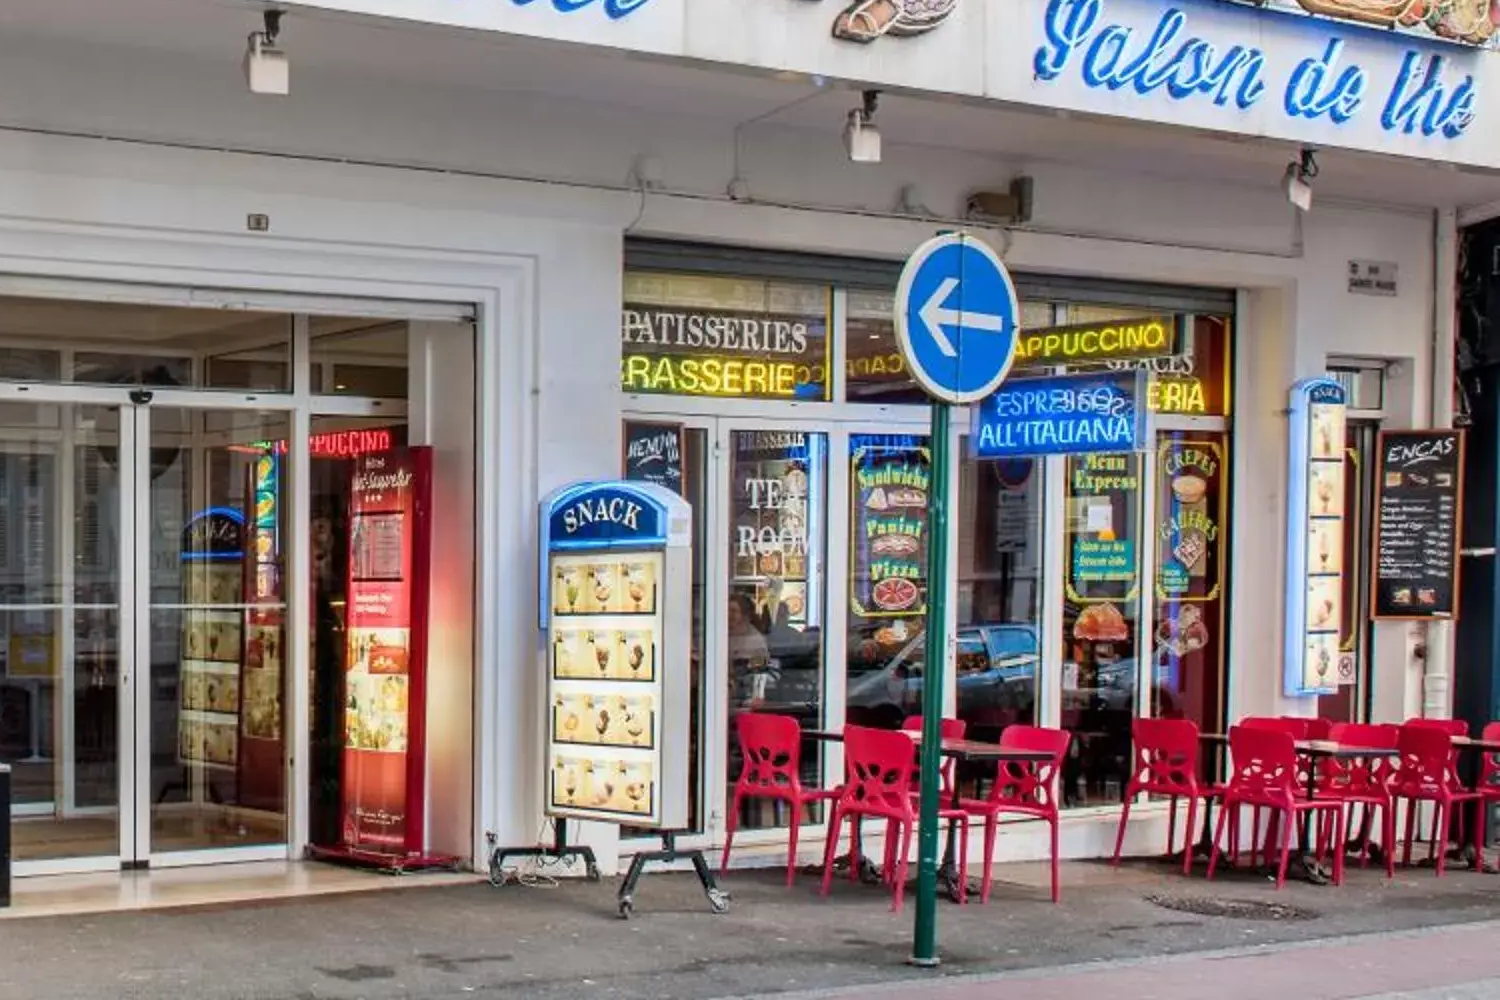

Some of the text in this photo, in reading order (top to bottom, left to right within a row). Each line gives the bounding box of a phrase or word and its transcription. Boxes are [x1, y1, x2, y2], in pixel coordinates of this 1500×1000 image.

[1284, 37, 1368, 124] de
[622, 311, 808, 354] PATISSERIES
[1013, 322, 1165, 358] APPUCCINO
[620, 354, 797, 394] RASSERIE
[1387, 437, 1456, 463] ENCAS
[1074, 469, 1138, 494] Express
[562, 496, 643, 534] SNACK
[866, 516, 923, 538] Panini
[870, 558, 920, 581] Pizza
